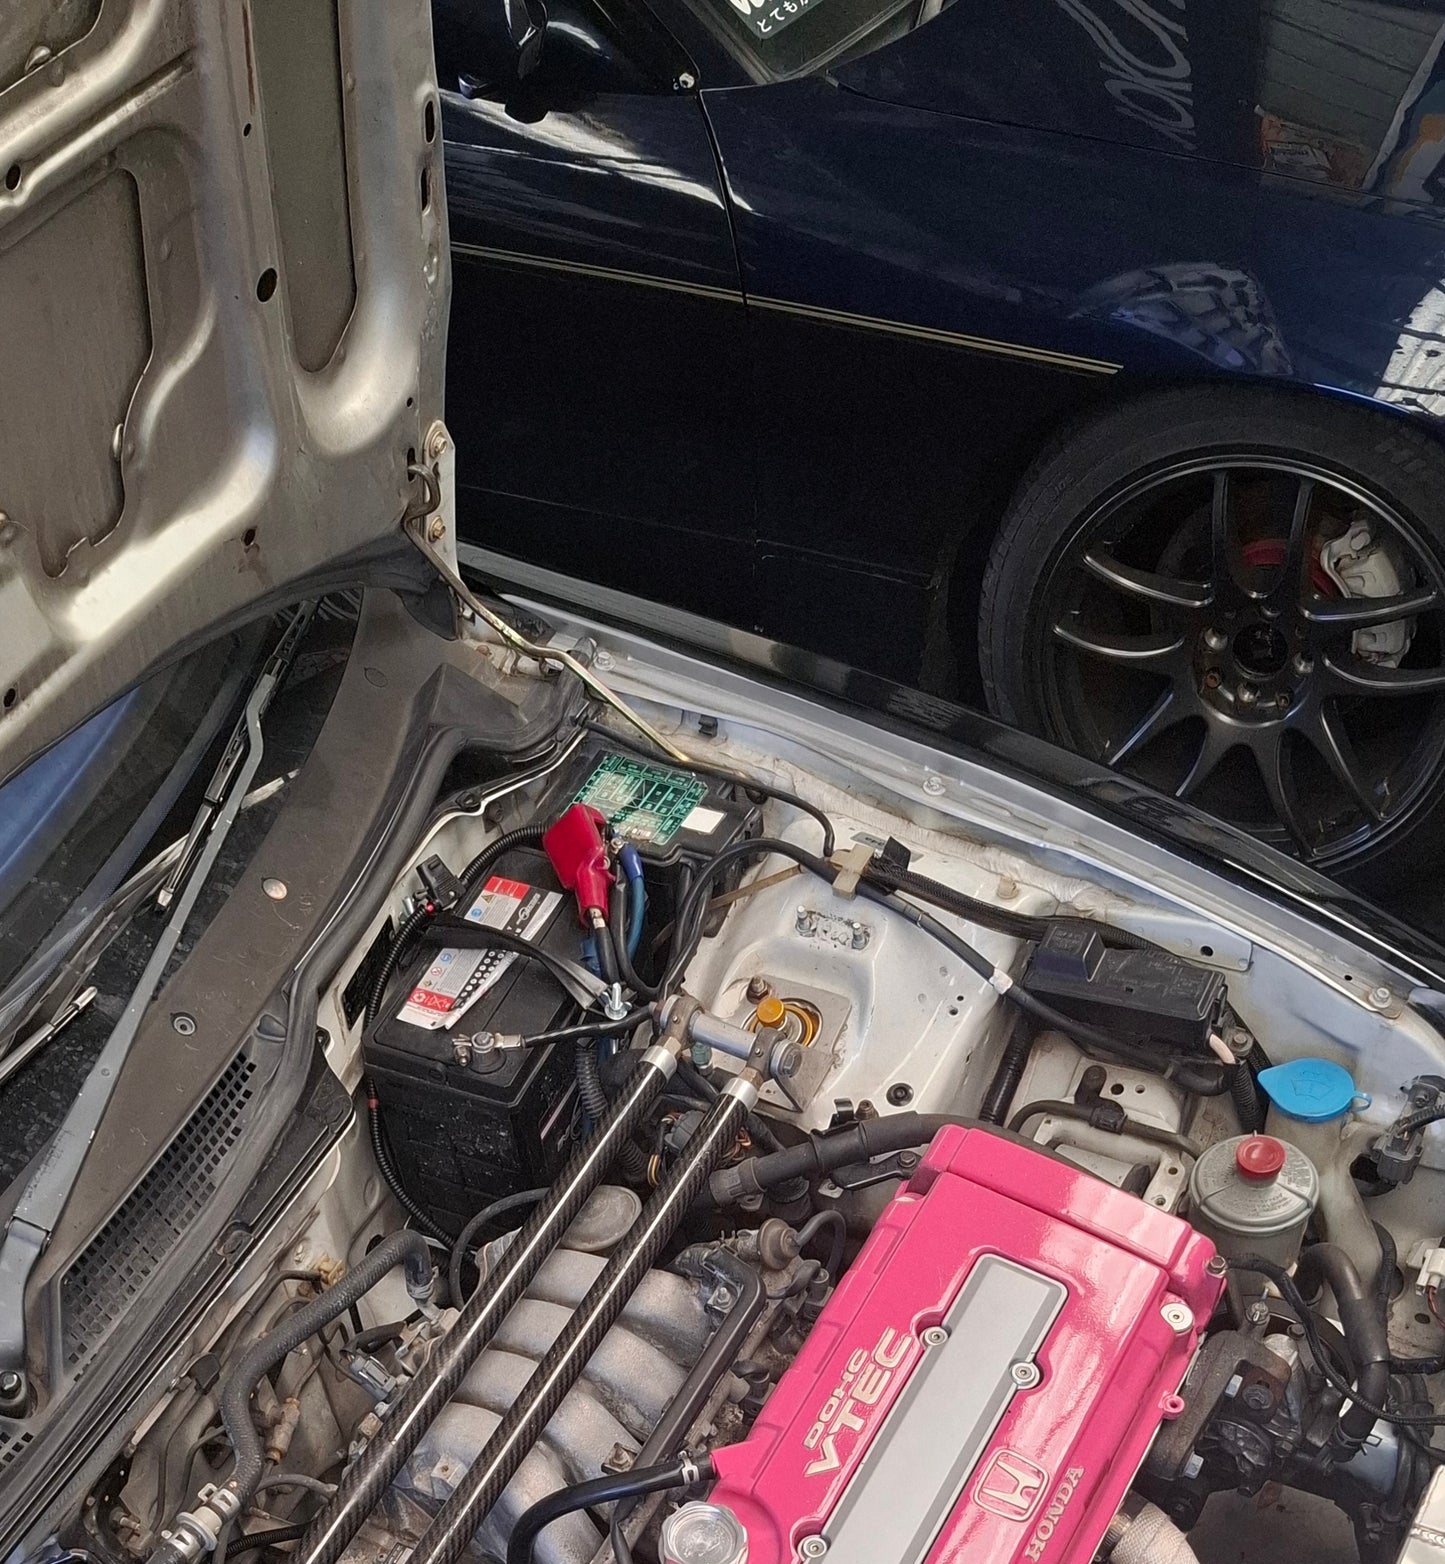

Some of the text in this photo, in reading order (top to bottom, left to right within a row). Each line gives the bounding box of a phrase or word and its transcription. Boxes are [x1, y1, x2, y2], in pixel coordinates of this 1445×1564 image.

[802, 1347, 868, 1450] DOHC
[805, 1325, 913, 1477] VTEC
[1024, 1467, 1084, 1563] HONDA
